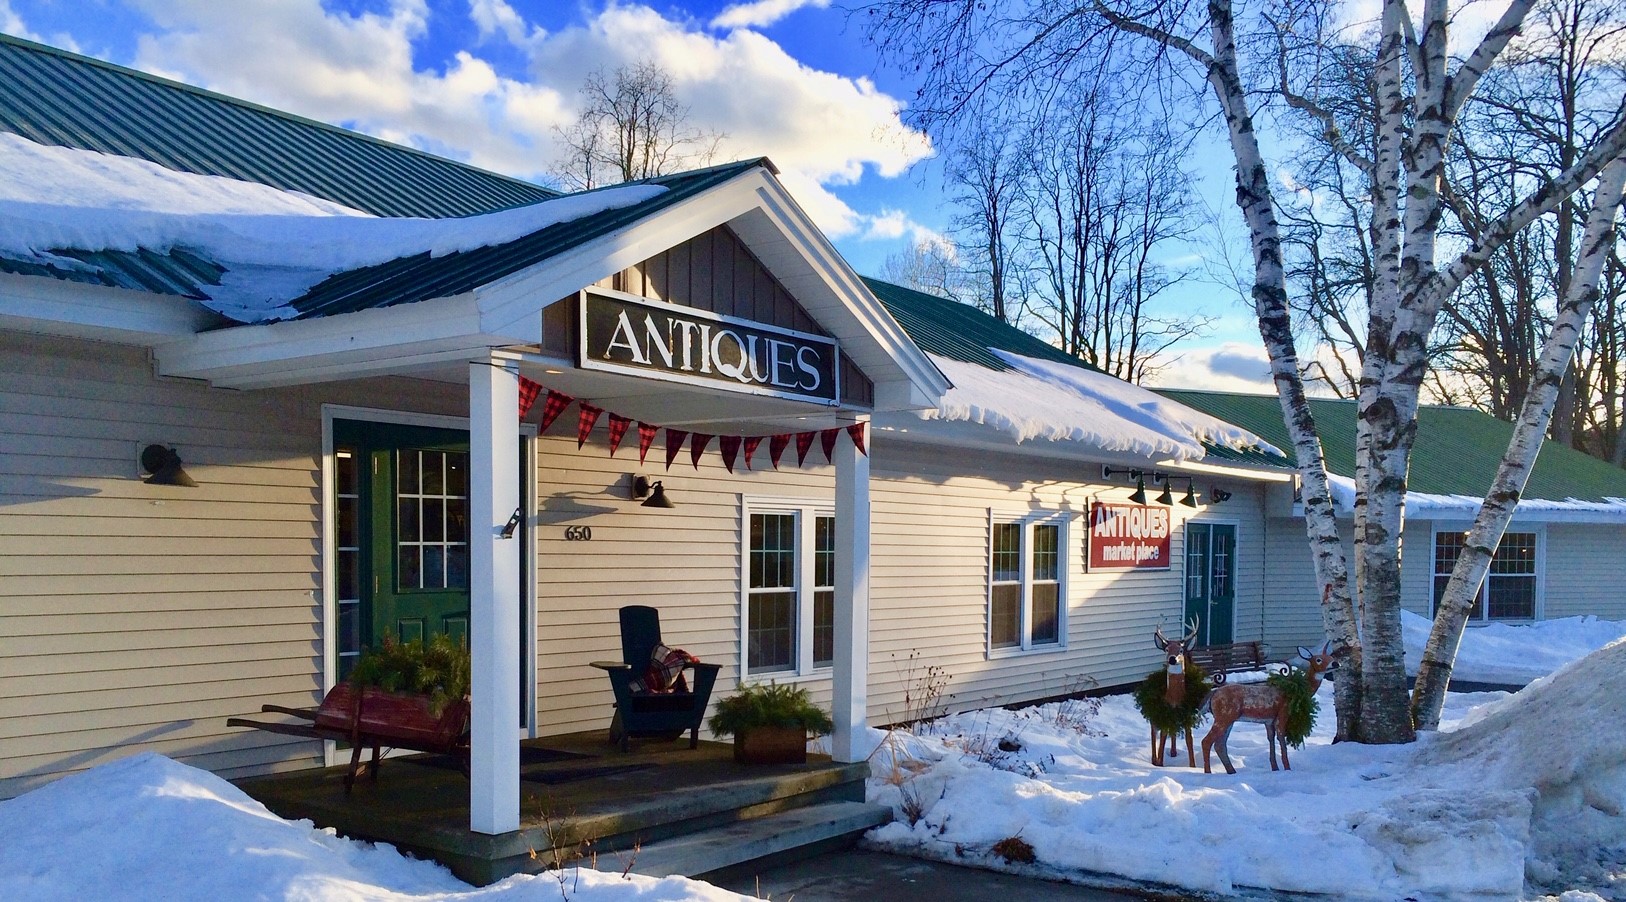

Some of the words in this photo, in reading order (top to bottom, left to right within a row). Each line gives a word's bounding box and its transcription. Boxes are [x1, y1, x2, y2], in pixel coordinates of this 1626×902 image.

[602, 308, 820, 391] ANTIQUES
[565, 525, 592, 541] 650
[1094, 506, 1168, 541] ANTIQUES
[1103, 541, 1135, 561] market
[1136, 541, 1160, 565] place
